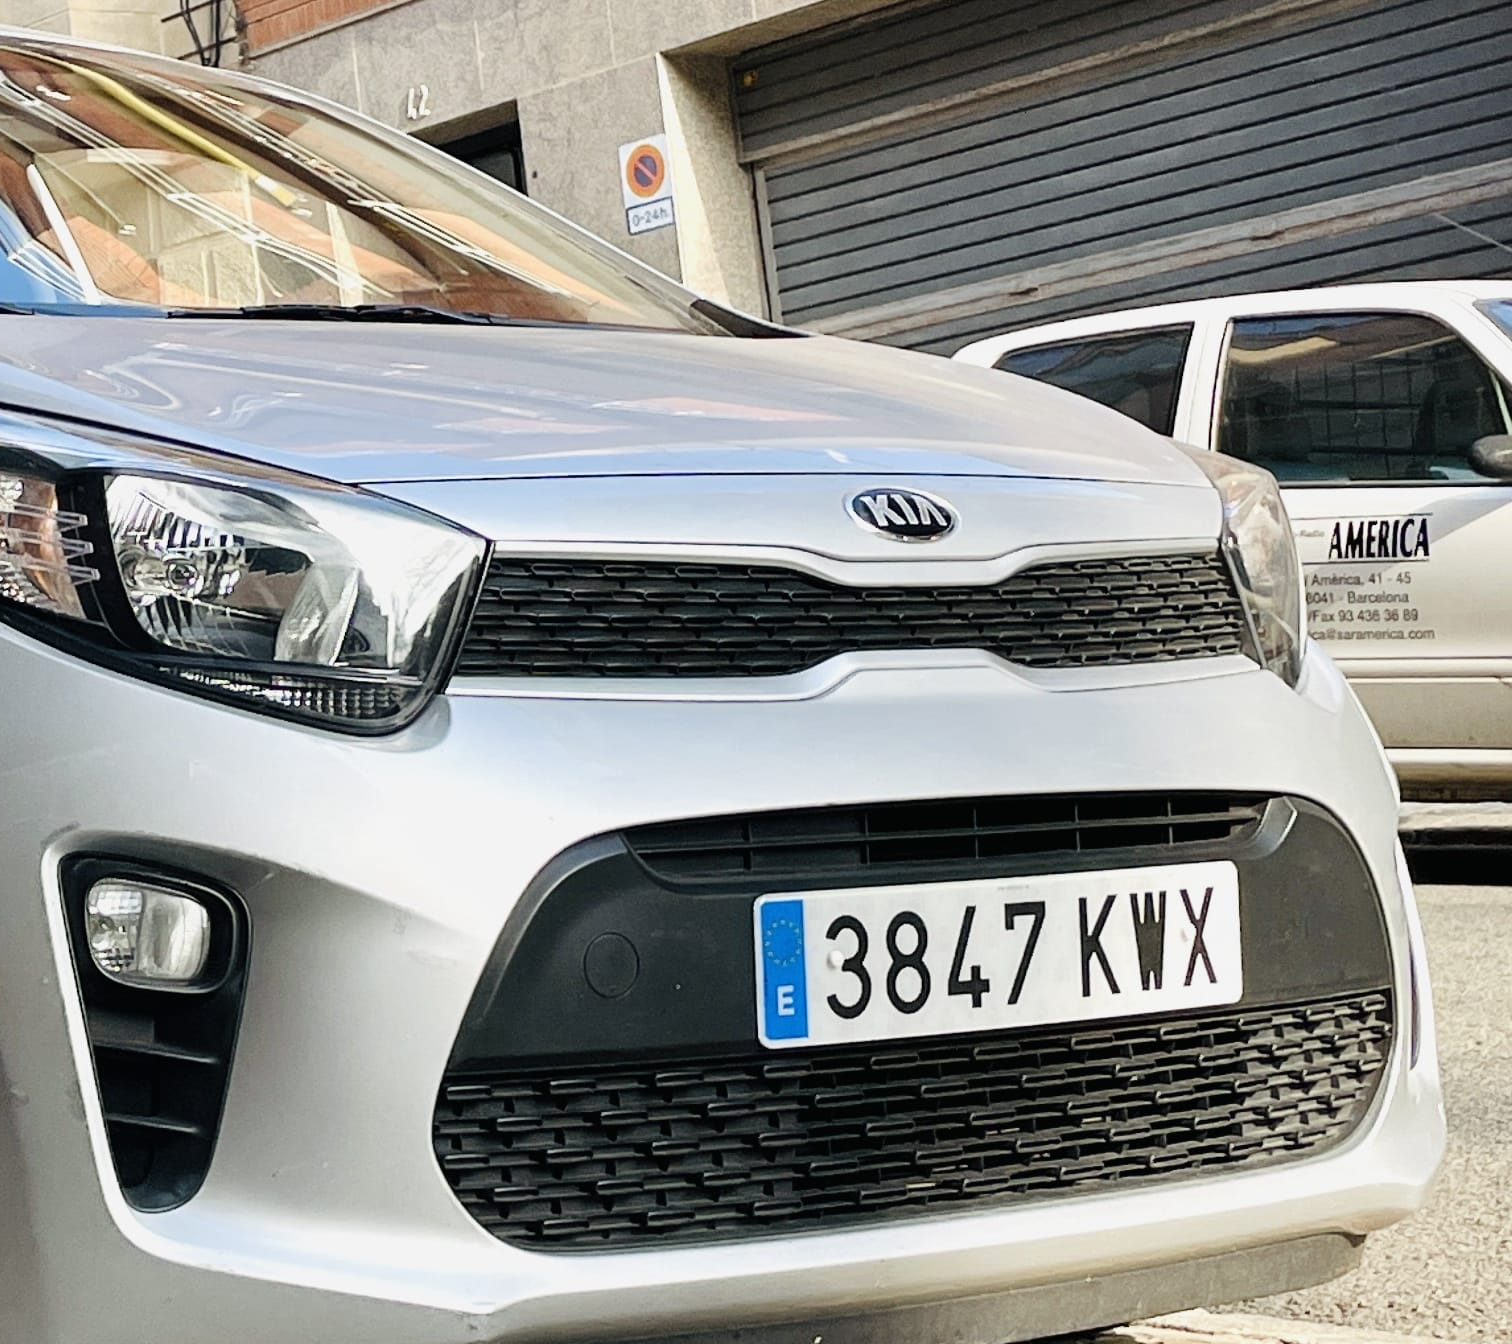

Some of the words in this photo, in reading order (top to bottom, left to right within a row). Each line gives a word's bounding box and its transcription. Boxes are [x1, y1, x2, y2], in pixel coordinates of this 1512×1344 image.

[859, 493, 948, 528] KIA
[1328, 518, 1430, 560] AMERICA
[1347, 590, 1410, 604] Barcelona
[1338, 609, 1354, 622] 93
[825, 901, 1047, 1020] 3847
[1077, 886, 1218, 999] KWX
[777, 984, 796, 1017] E
